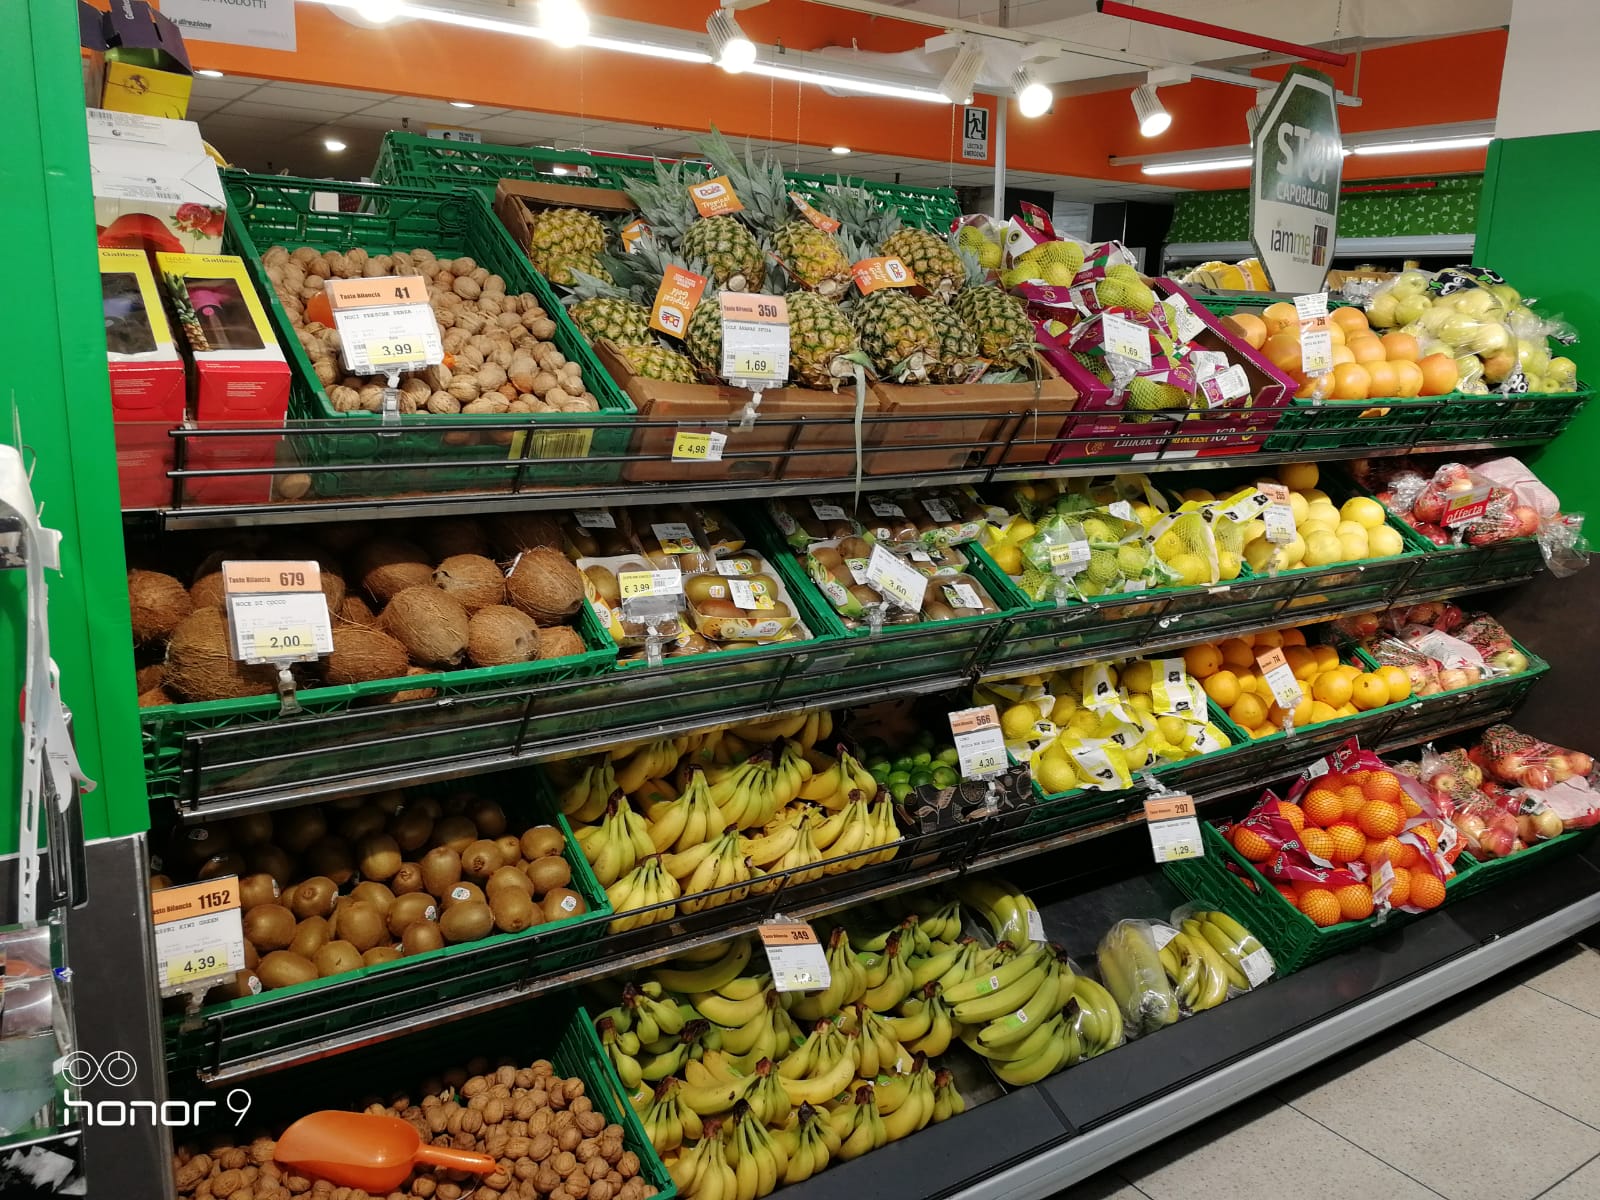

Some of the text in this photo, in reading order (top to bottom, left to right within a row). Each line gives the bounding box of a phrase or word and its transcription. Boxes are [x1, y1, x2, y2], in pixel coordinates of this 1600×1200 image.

[219, 0, 267, 9] RODOTTI
[179, 19, 212, 29] direzione
[1276, 122, 1337, 184] STOP
[1277, 182, 1329, 211] CAPORALATO
[395, 287, 410, 299] 41
[758, 304, 778, 318] 350
[382, 344, 412, 357] 3,99
[746, 360, 766, 372] 1,69
[688, 445, 705, 454] 4,98
[1446, 506, 1483, 523] offerta
[280, 572, 304, 586] 679
[270, 635, 300, 649] 2,00
[976, 714, 991, 726] 566
[979, 757, 994, 769] 4,30
[1175, 803, 1188, 814] 297
[1174, 846, 1189, 856] 1,29
[153, 890, 230, 915] asto Bilancia 1152
[156, 917, 219, 935] ESPRI KIWI GREEN
[791, 931, 810, 941] 349
[184, 956, 215, 974] 4,39
